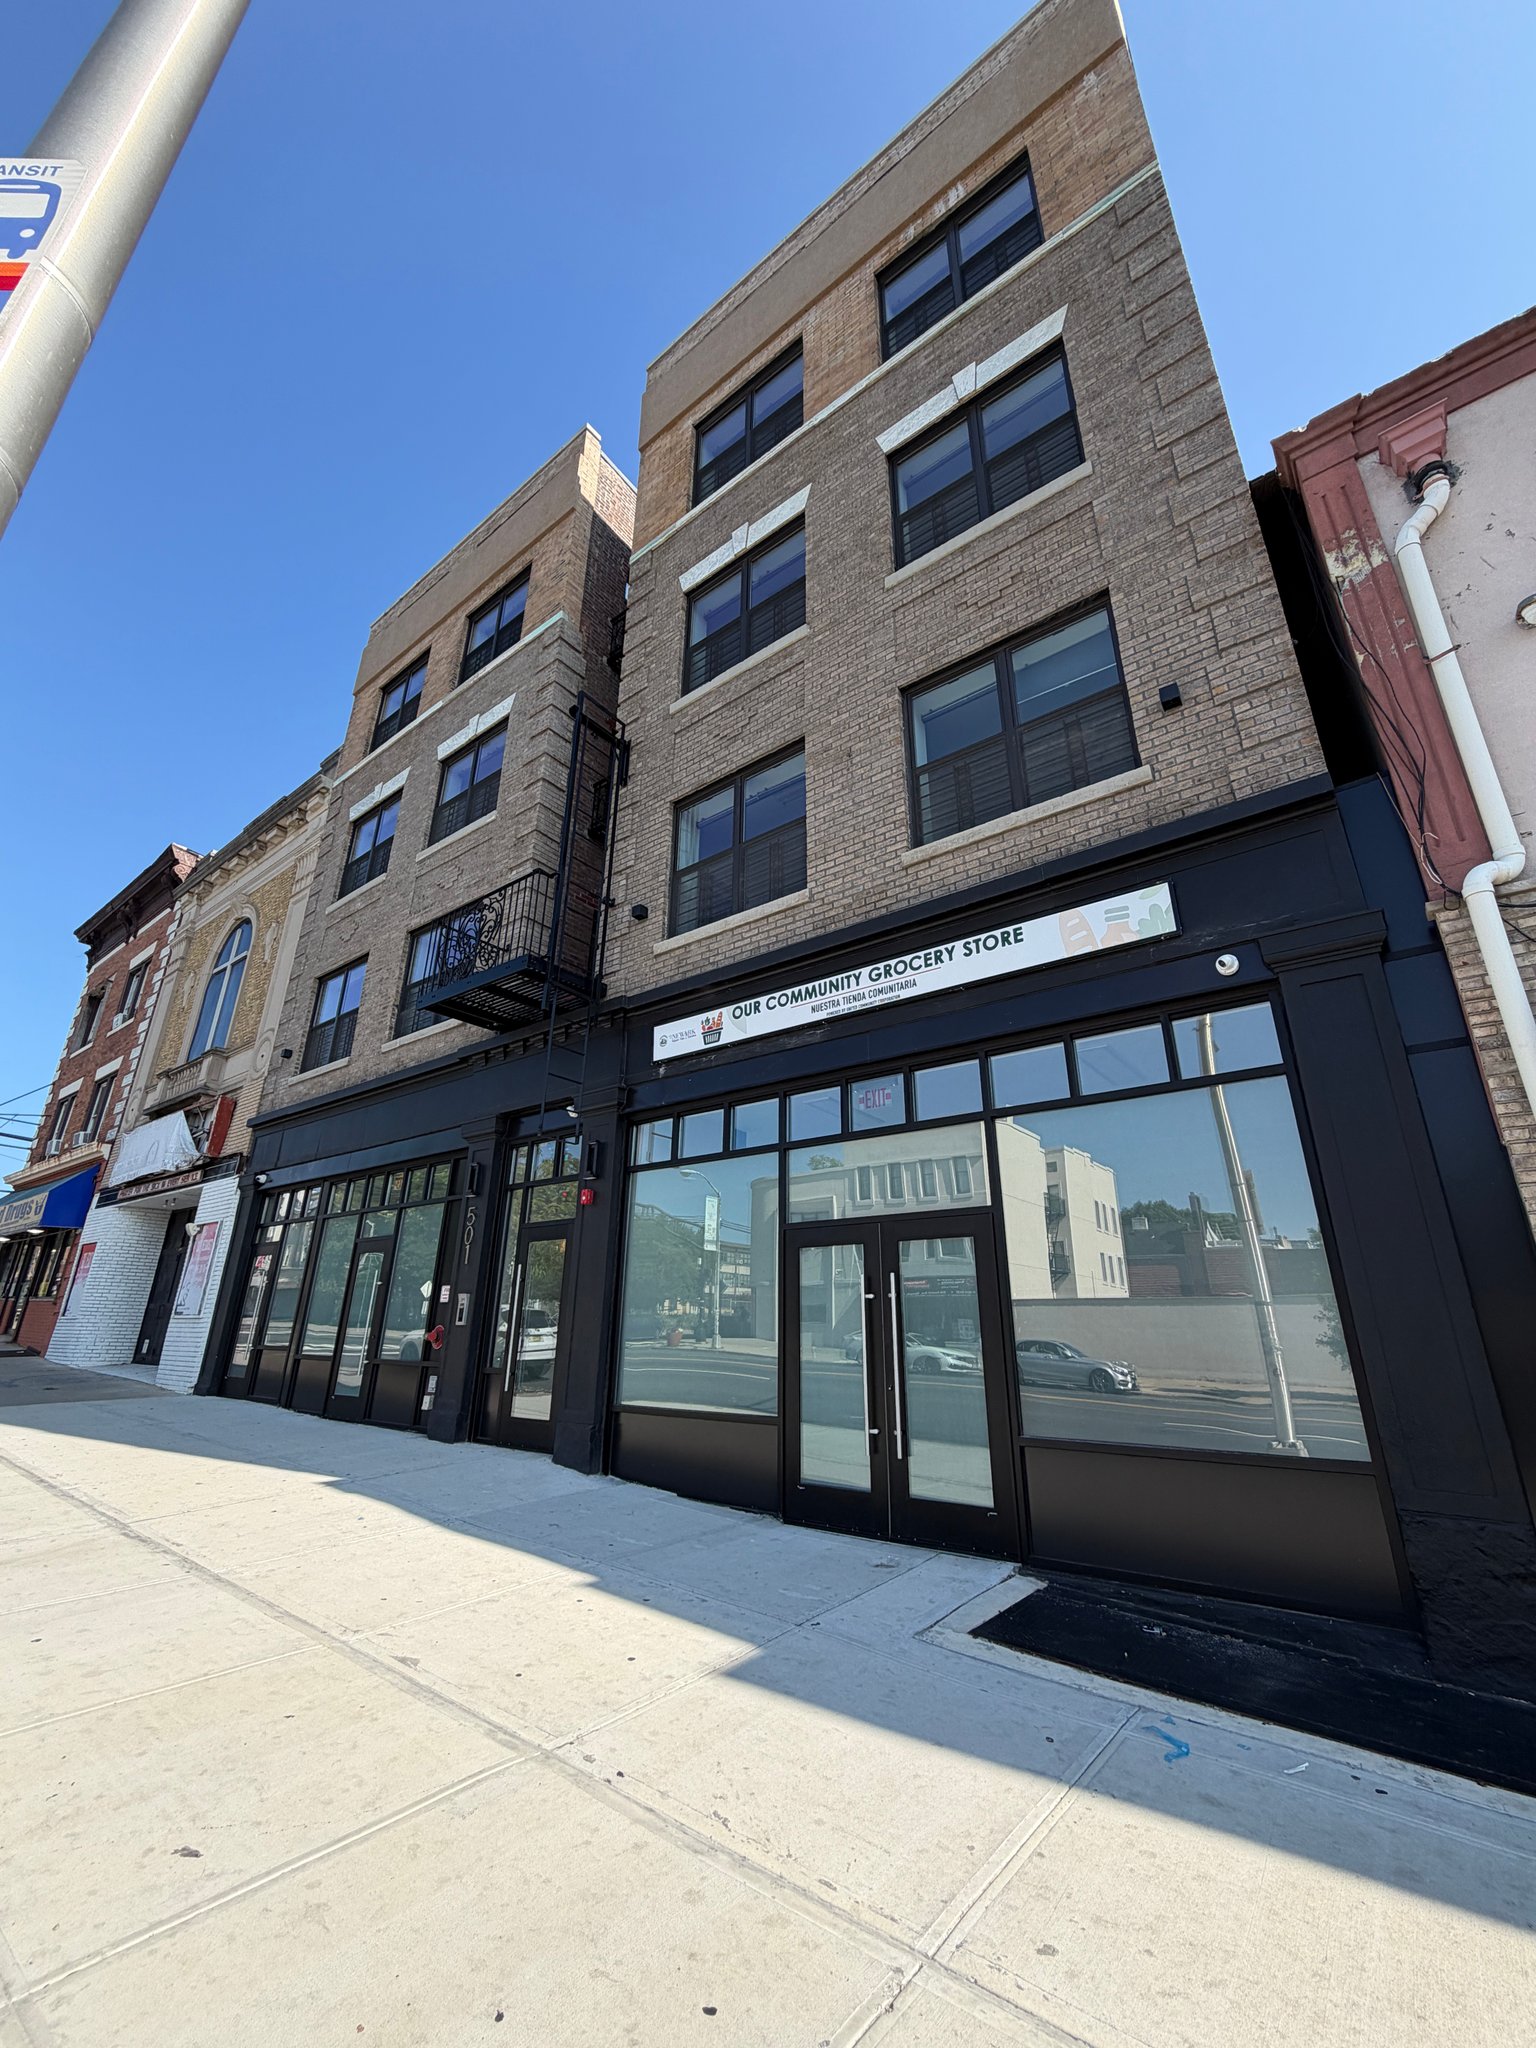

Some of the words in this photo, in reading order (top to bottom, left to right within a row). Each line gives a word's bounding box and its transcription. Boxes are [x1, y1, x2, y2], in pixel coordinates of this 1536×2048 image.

[732, 1000, 761, 1020] OUR
[765, 971, 862, 1011] COMMUNITY
[868, 945, 956, 983] GROCERY
[962, 926, 1024, 958] STORE
[811, 999, 840, 1014] NUESTRA
[842, 991, 867, 1006] TIENDA
[868, 978, 918, 999] COMUNITARIA
[865, 1087, 886, 1109] EXIT
[4, 1199, 33, 1222] Drugs
[464, 1206, 476, 1264] 501
